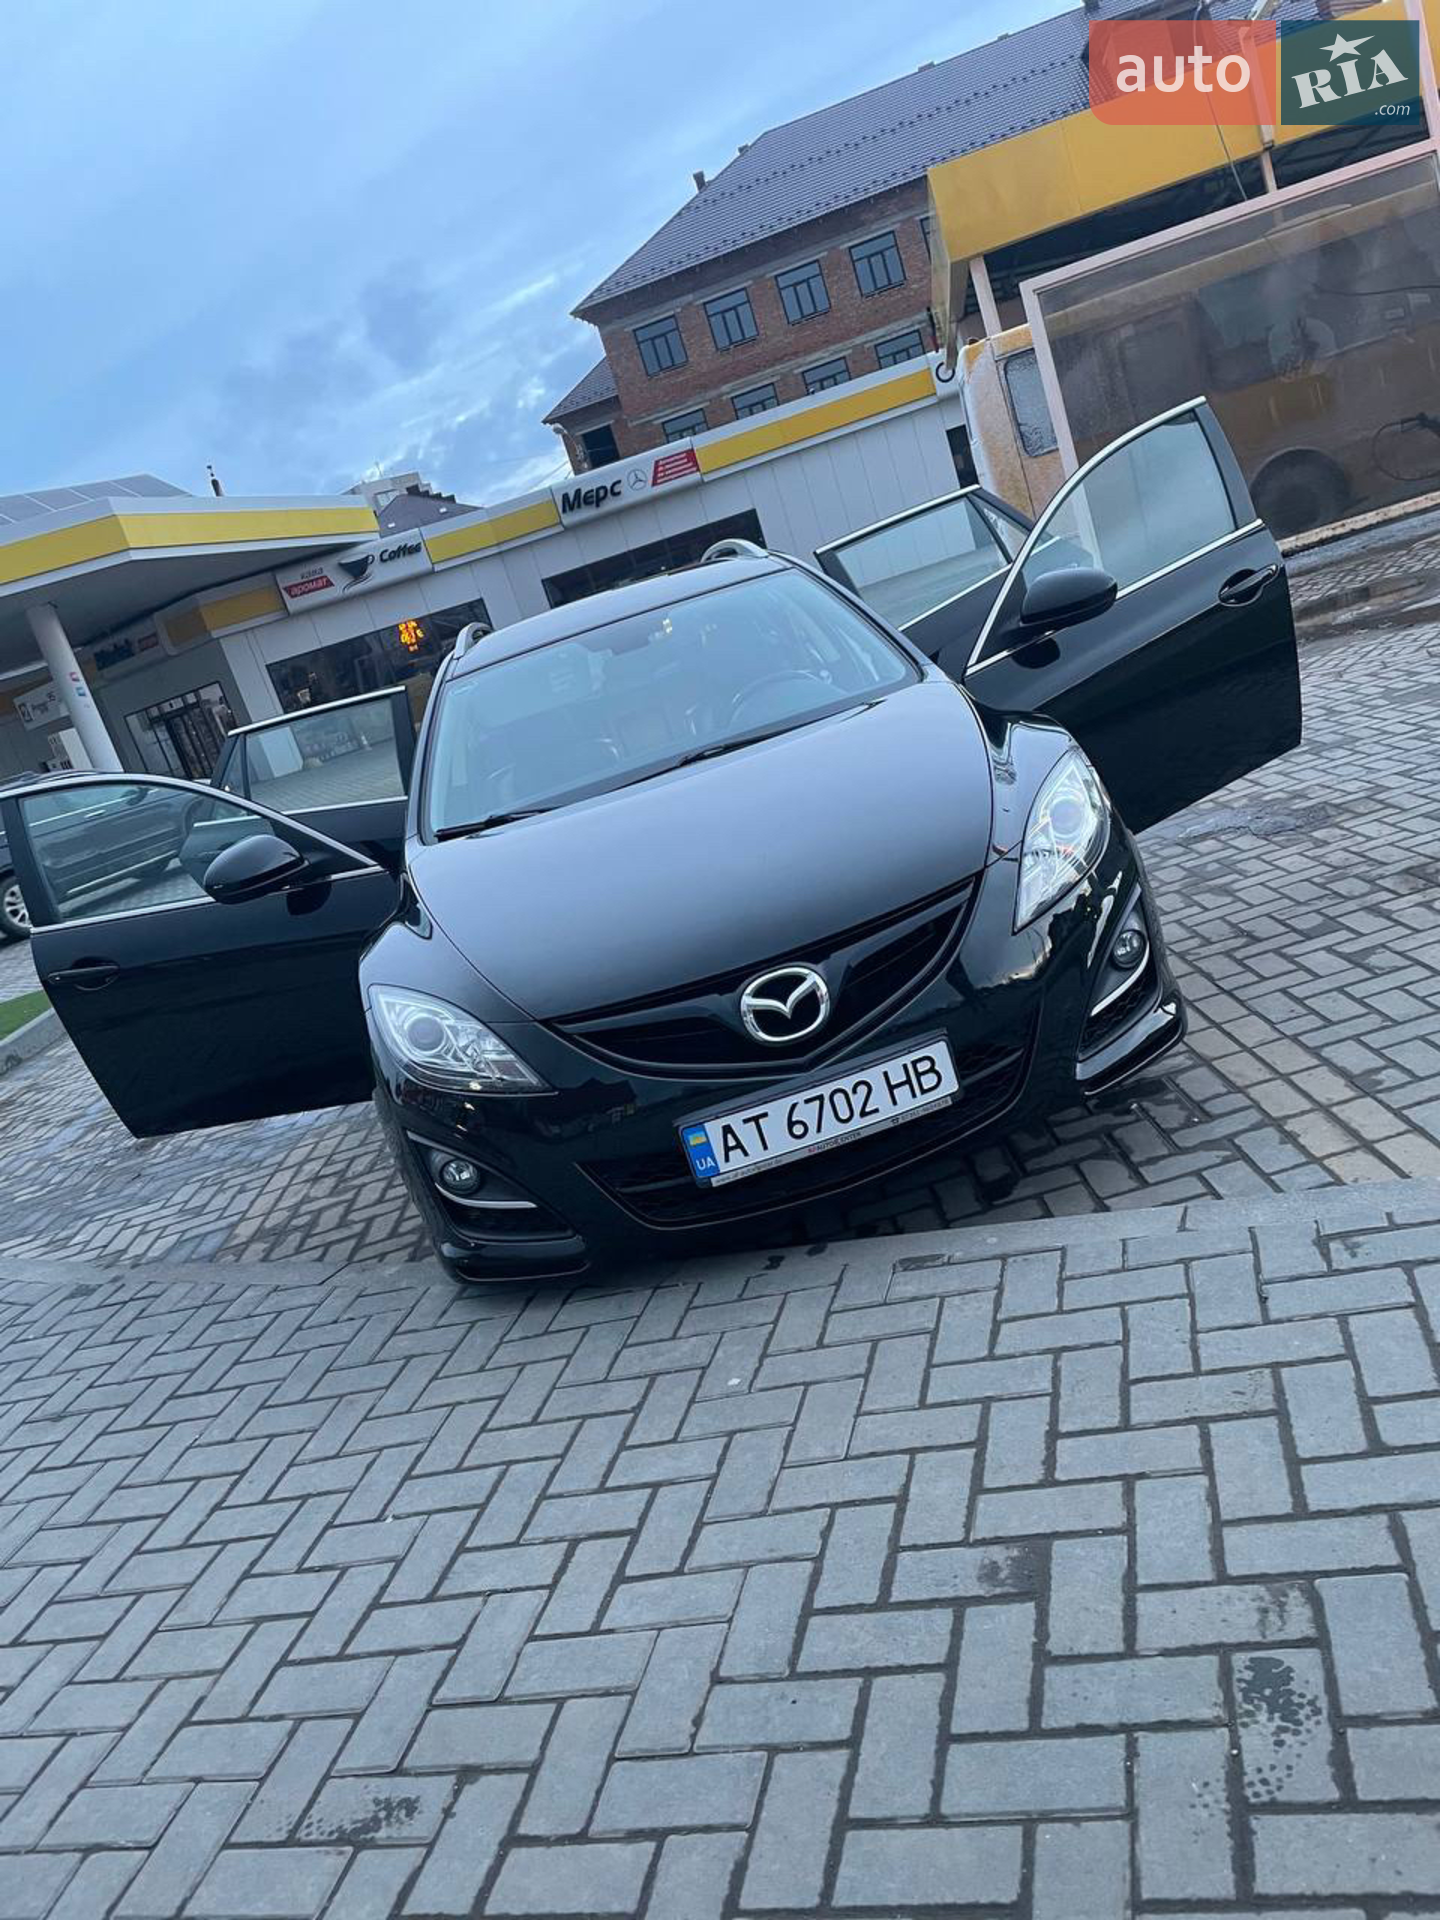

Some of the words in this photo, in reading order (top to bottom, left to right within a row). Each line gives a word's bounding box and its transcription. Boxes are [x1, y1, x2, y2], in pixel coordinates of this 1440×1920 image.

[379, 542, 422, 563] Coffee
[719, 1111, 771, 1164] AT
[786, 1079, 880, 1141] 6702
[882, 1054, 943, 1107] HB
[695, 1157, 717, 1172] UA
